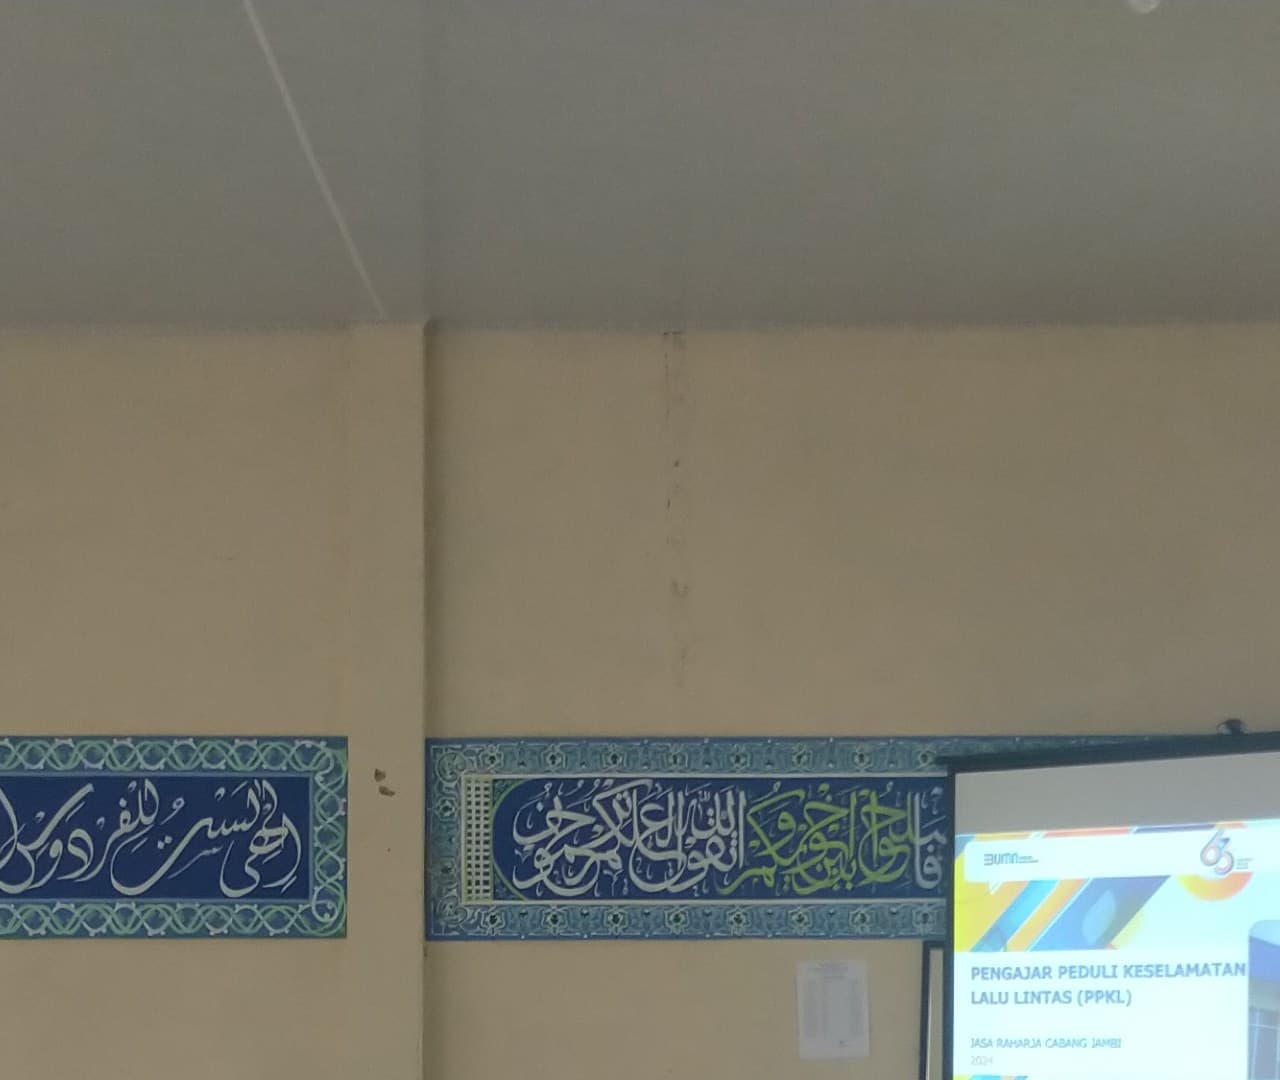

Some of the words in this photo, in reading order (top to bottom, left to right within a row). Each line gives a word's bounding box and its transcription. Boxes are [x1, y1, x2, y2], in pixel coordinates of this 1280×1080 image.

[970, 965, 1053, 981] PENGAJAR
[1058, 964, 1118, 980] PEDULI
[1123, 962, 1247, 979] KESELAMATAN
[970, 990, 1009, 1005] LALU
[1014, 990, 1072, 1005] LINTAS
[1077, 989, 1132, 1007] (PPKL)
[970, 1037, 993, 1049] JASA
[996, 1037, 1042, 1049] RAHARJA
[1045, 1037, 1087, 1049] CABANG
[1091, 1037, 1122, 1049] JAMBI
